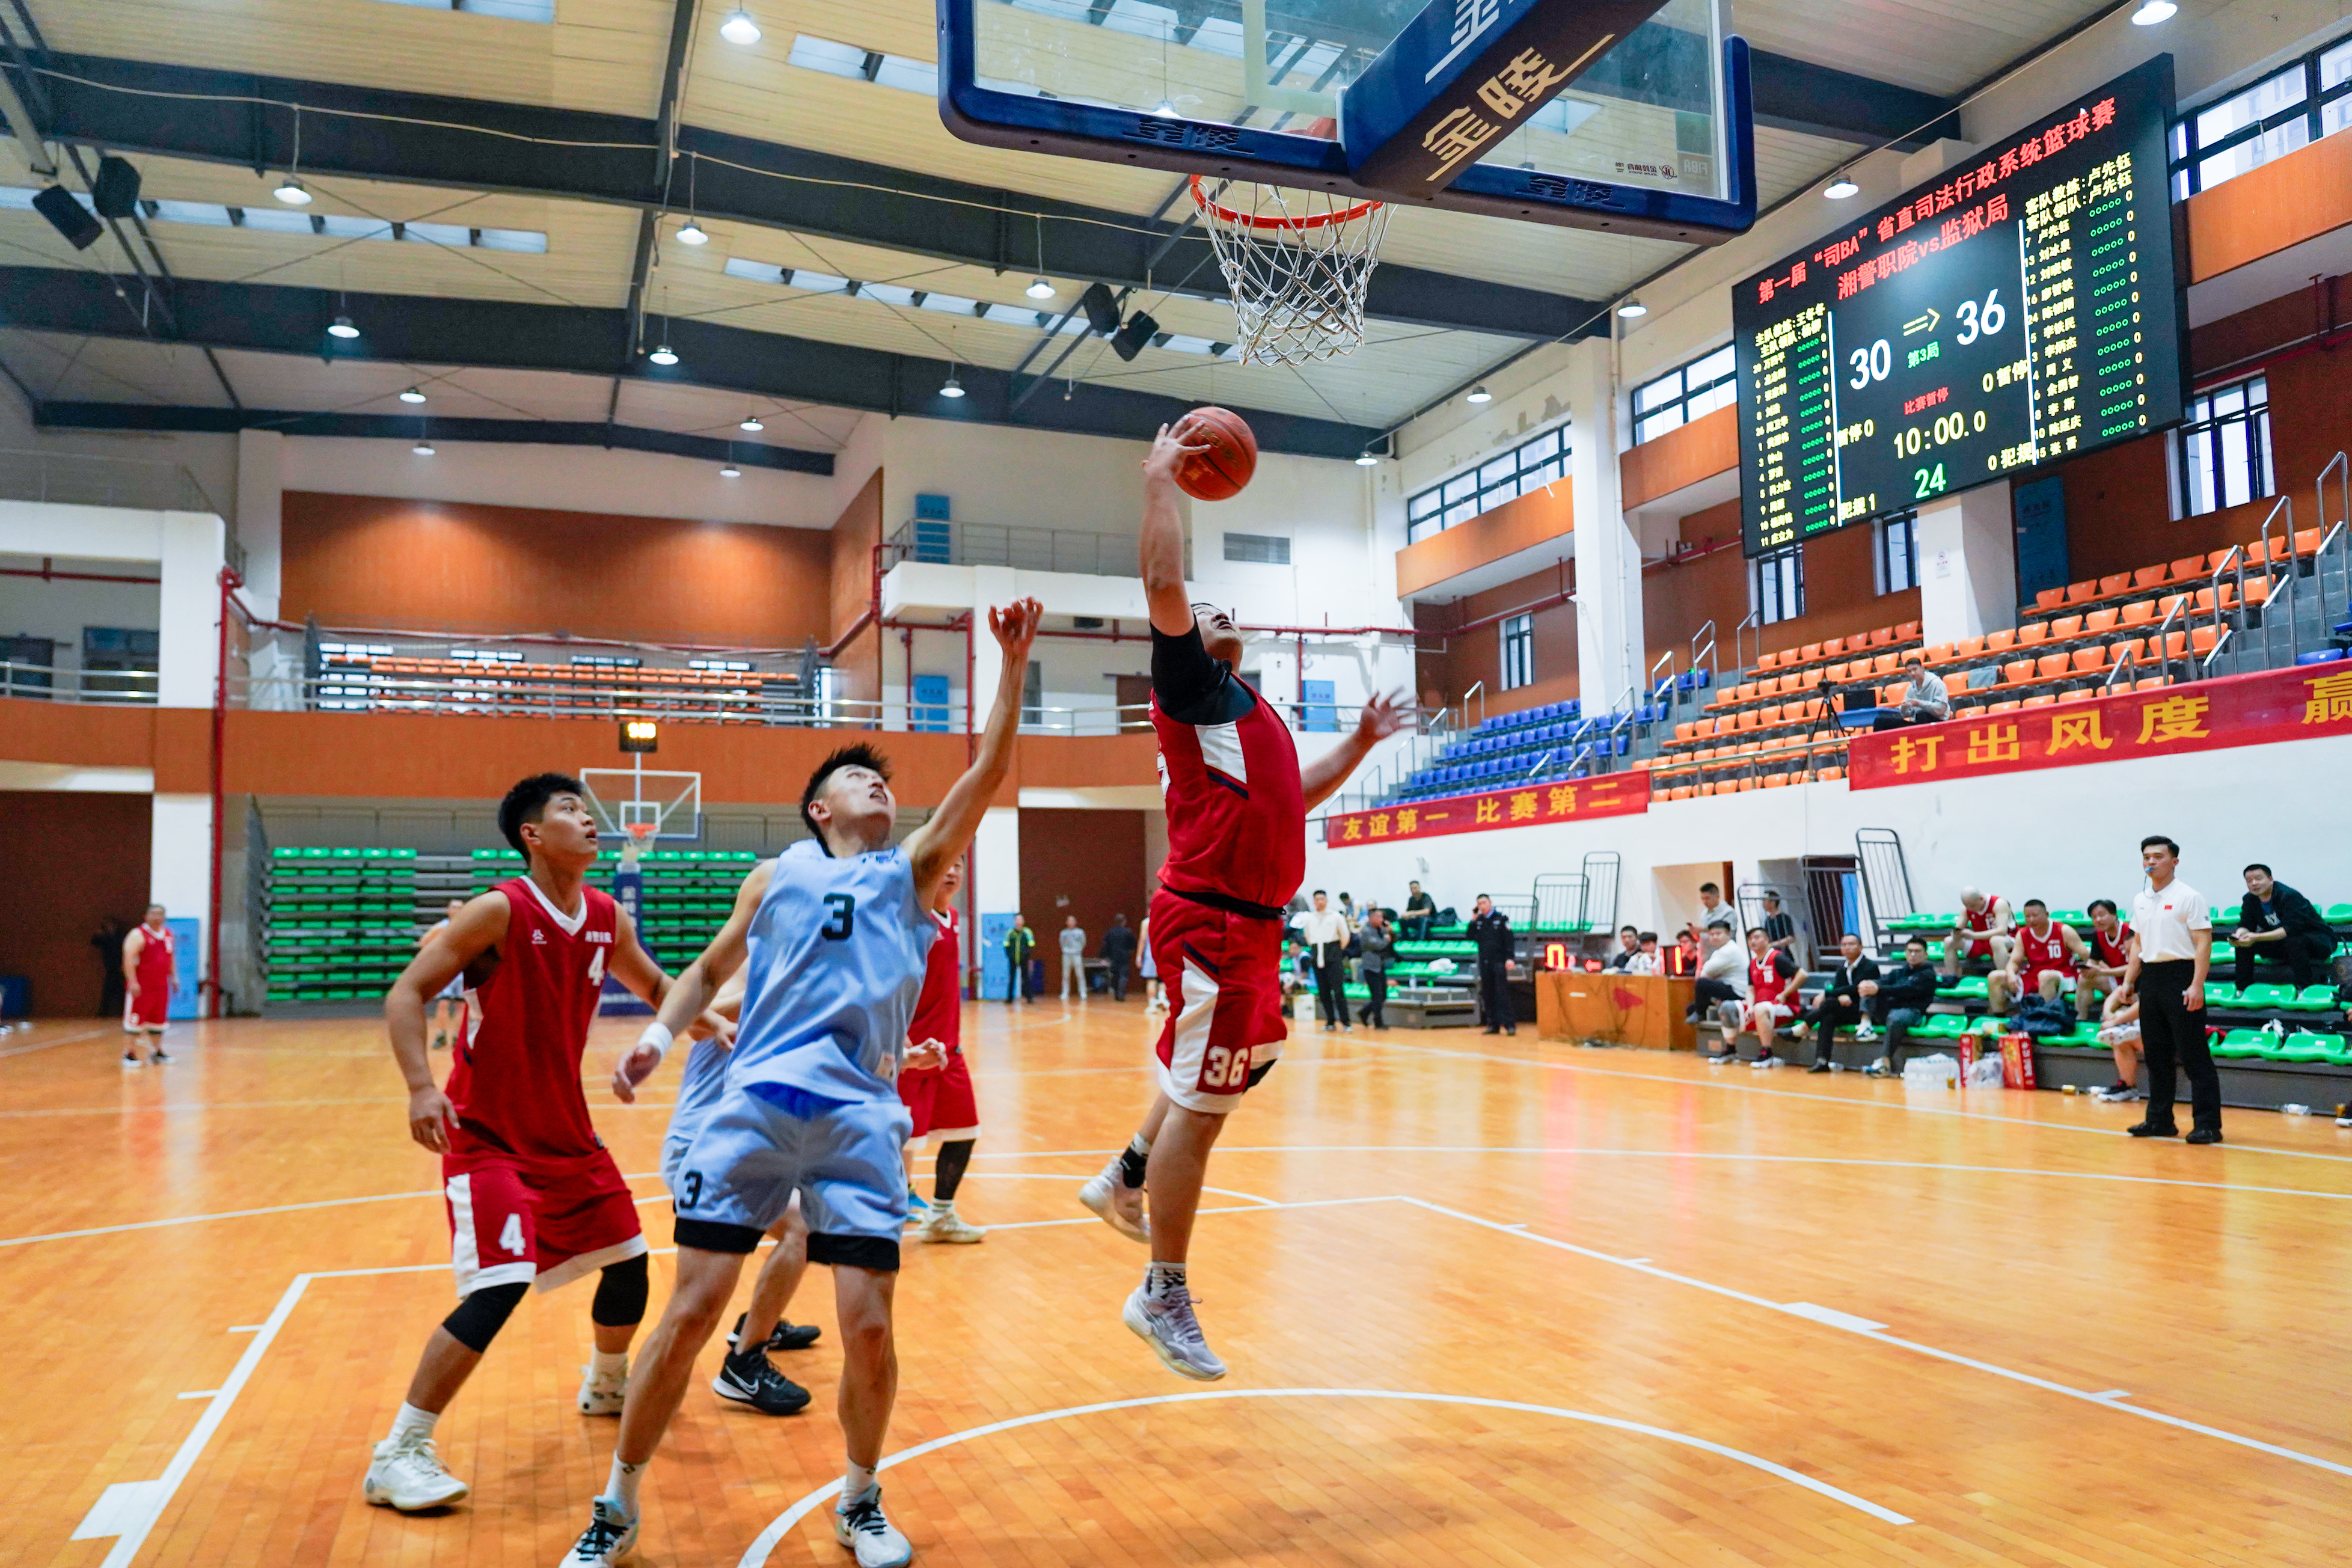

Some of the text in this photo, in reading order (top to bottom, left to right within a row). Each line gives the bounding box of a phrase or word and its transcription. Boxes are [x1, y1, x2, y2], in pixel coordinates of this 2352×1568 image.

[1422, 34, 1615, 181] 金陵
[2025, 237, 2031, 248] 7
[2125, 190, 2133, 201] 0
[2126, 210, 2134, 221] 0
[1838, 194, 2009, 300] 湘警职院vs监狱局
[2127, 230, 2135, 242] 0
[2128, 251, 2137, 263] 0
[2130, 271, 2138, 283] 0
[1955, 289, 2006, 345] 36
[2030, 332, 2037, 343] 5
[2131, 291, 2139, 303] 0
[1821, 333, 1827, 342] 0
[1822, 349, 1828, 359] 0
[2032, 352, 2038, 363] 3
[2133, 311, 2140, 323] 0
[1822, 366, 1828, 375] 0
[1849, 338, 1891, 390] 30
[1907, 341, 1940, 368] 第3局
[2032, 370, 2039, 381] 4
[2134, 332, 2142, 343] 0
[1823, 382, 1829, 392] 0
[1982, 360, 2028, 393] 0 暂停
[2034, 390, 2041, 400] 6
[2135, 352, 2143, 363] 0
[1824, 399, 1830, 409] 0
[1904, 387, 1949, 415] 比赛暂停
[2035, 409, 2042, 421] 8
[2136, 373, 2144, 385] 0
[1825, 415, 1831, 425] 0
[2035, 428, 2046, 439] 10
[2137, 393, 2145, 405] 0
[1759, 458, 1764, 467] 3
[1825, 432, 1832, 441] 0
[1827, 448, 1833, 458] 0
[2036, 447, 2047, 459] 15
[2139, 414, 2146, 426] 0
[1988, 442, 2033, 471] 0 犯规
[1760, 489, 1765, 498] 5
[1828, 465, 1834, 474] 0
[1828, 482, 1834, 492] 0
[1914, 463, 1946, 499] 24
[1760, 521, 1769, 531] 10
[1829, 498, 1835, 508] 0
[1840, 496, 1866, 520] 犯规
[1761, 537, 1769, 547] 11
[1830, 515, 1836, 525] 0
[1890, 694, 2210, 776] 打出风度
[1343, 782, 1622, 841] 友谊第一 比赛第二
[821, 892, 856, 941] 3
[588, 946, 605, 986] 4
[2047, 945, 2062, 959] 10
[1204, 1046, 1249, 1087] 36
[679, 1168, 703, 1210] 3
[498, 1213, 526, 1257] 4
